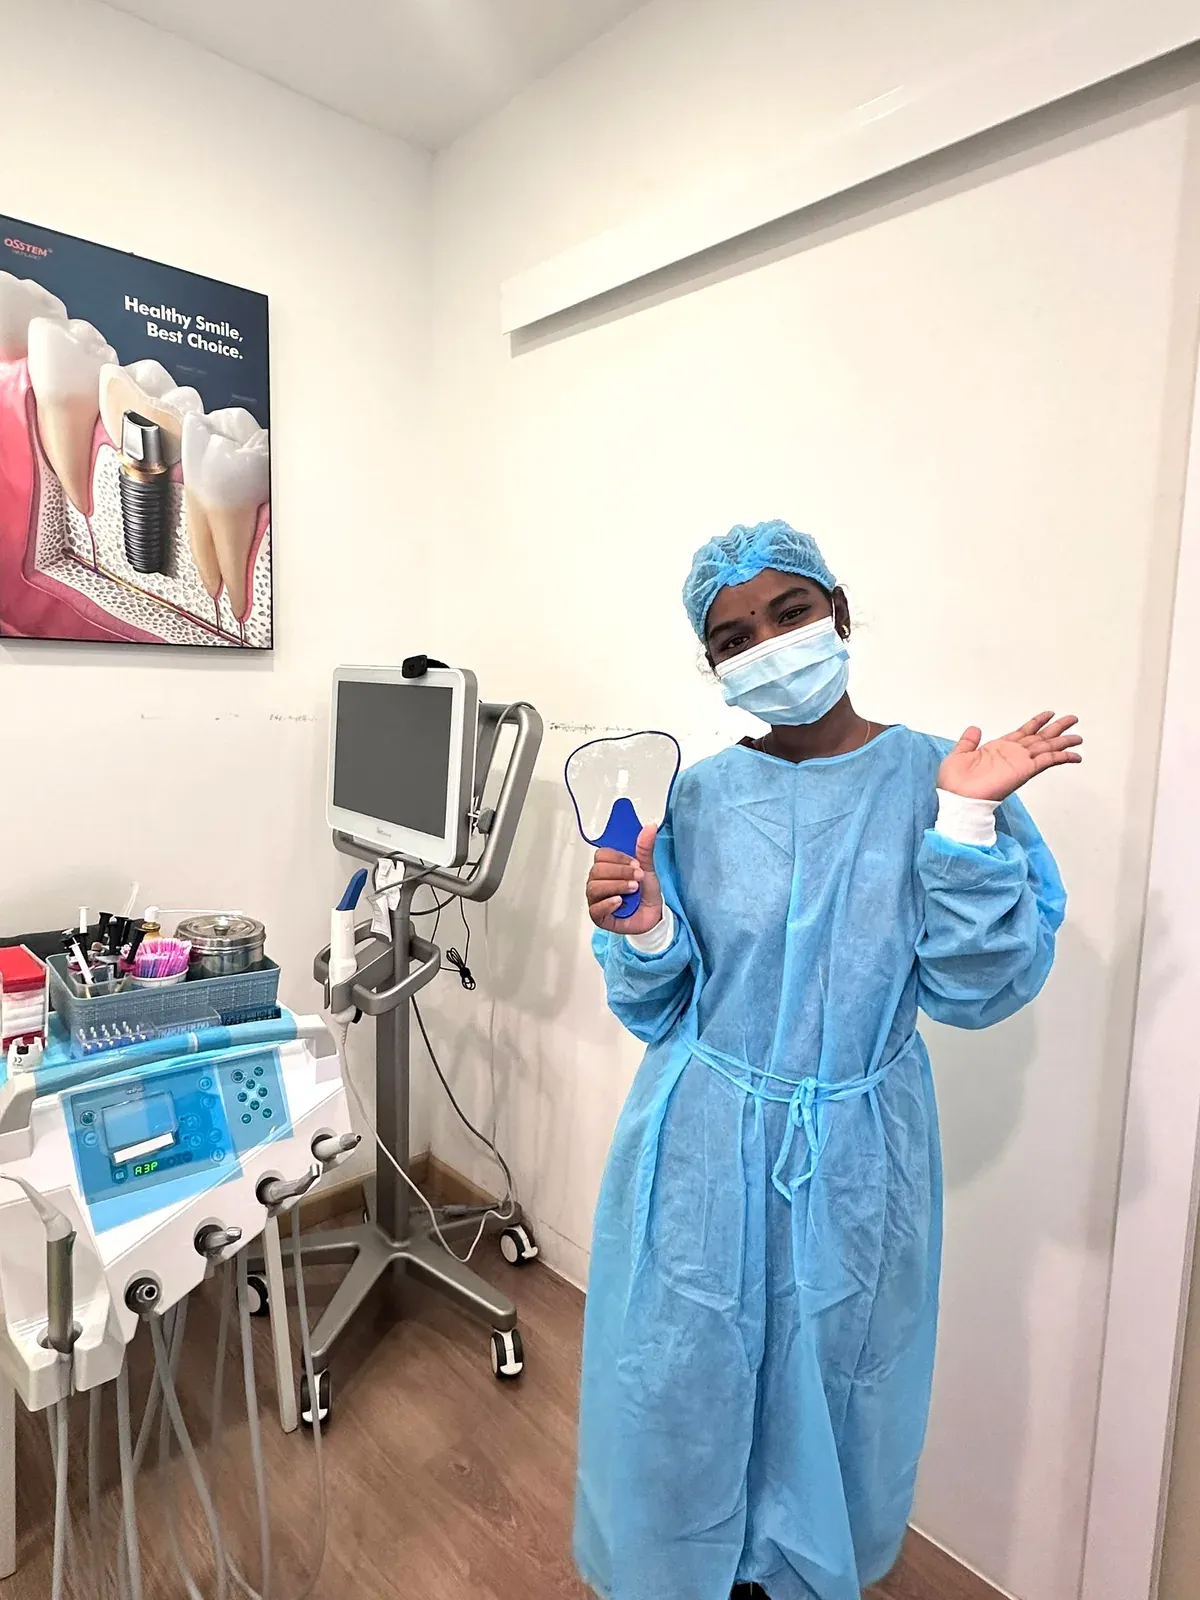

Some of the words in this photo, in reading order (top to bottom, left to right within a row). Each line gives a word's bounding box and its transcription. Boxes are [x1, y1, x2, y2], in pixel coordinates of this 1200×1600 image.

[124, 294, 192, 330] Healthy
[195, 315, 243, 343] Smile,
[146, 321, 183, 344] Best
[187, 333, 243, 360] Choice.
[135, 1161, 158, 1176] A3P
